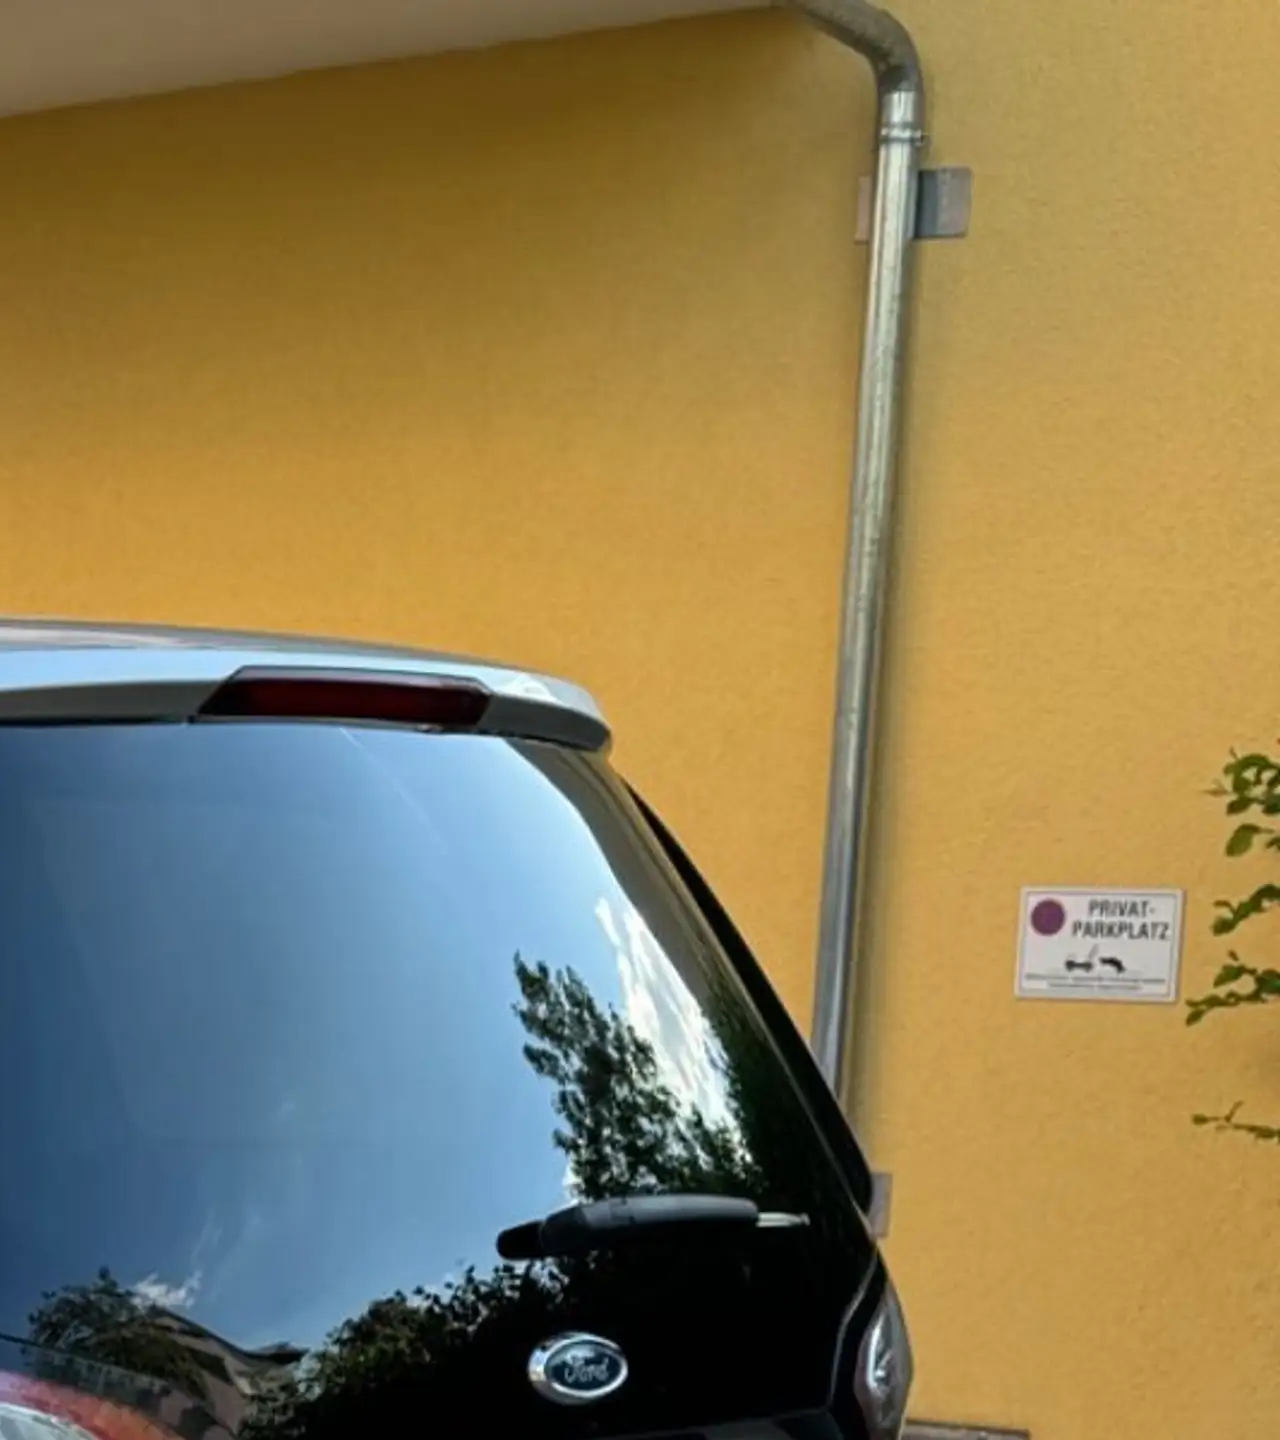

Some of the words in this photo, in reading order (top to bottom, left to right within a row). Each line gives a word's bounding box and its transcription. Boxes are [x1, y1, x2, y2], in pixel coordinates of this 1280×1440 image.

[1088, 899, 1156, 918] PRIVAT-
[1072, 921, 1170, 940] PARKPLATZ
[561, 1348, 610, 1383] Ford
